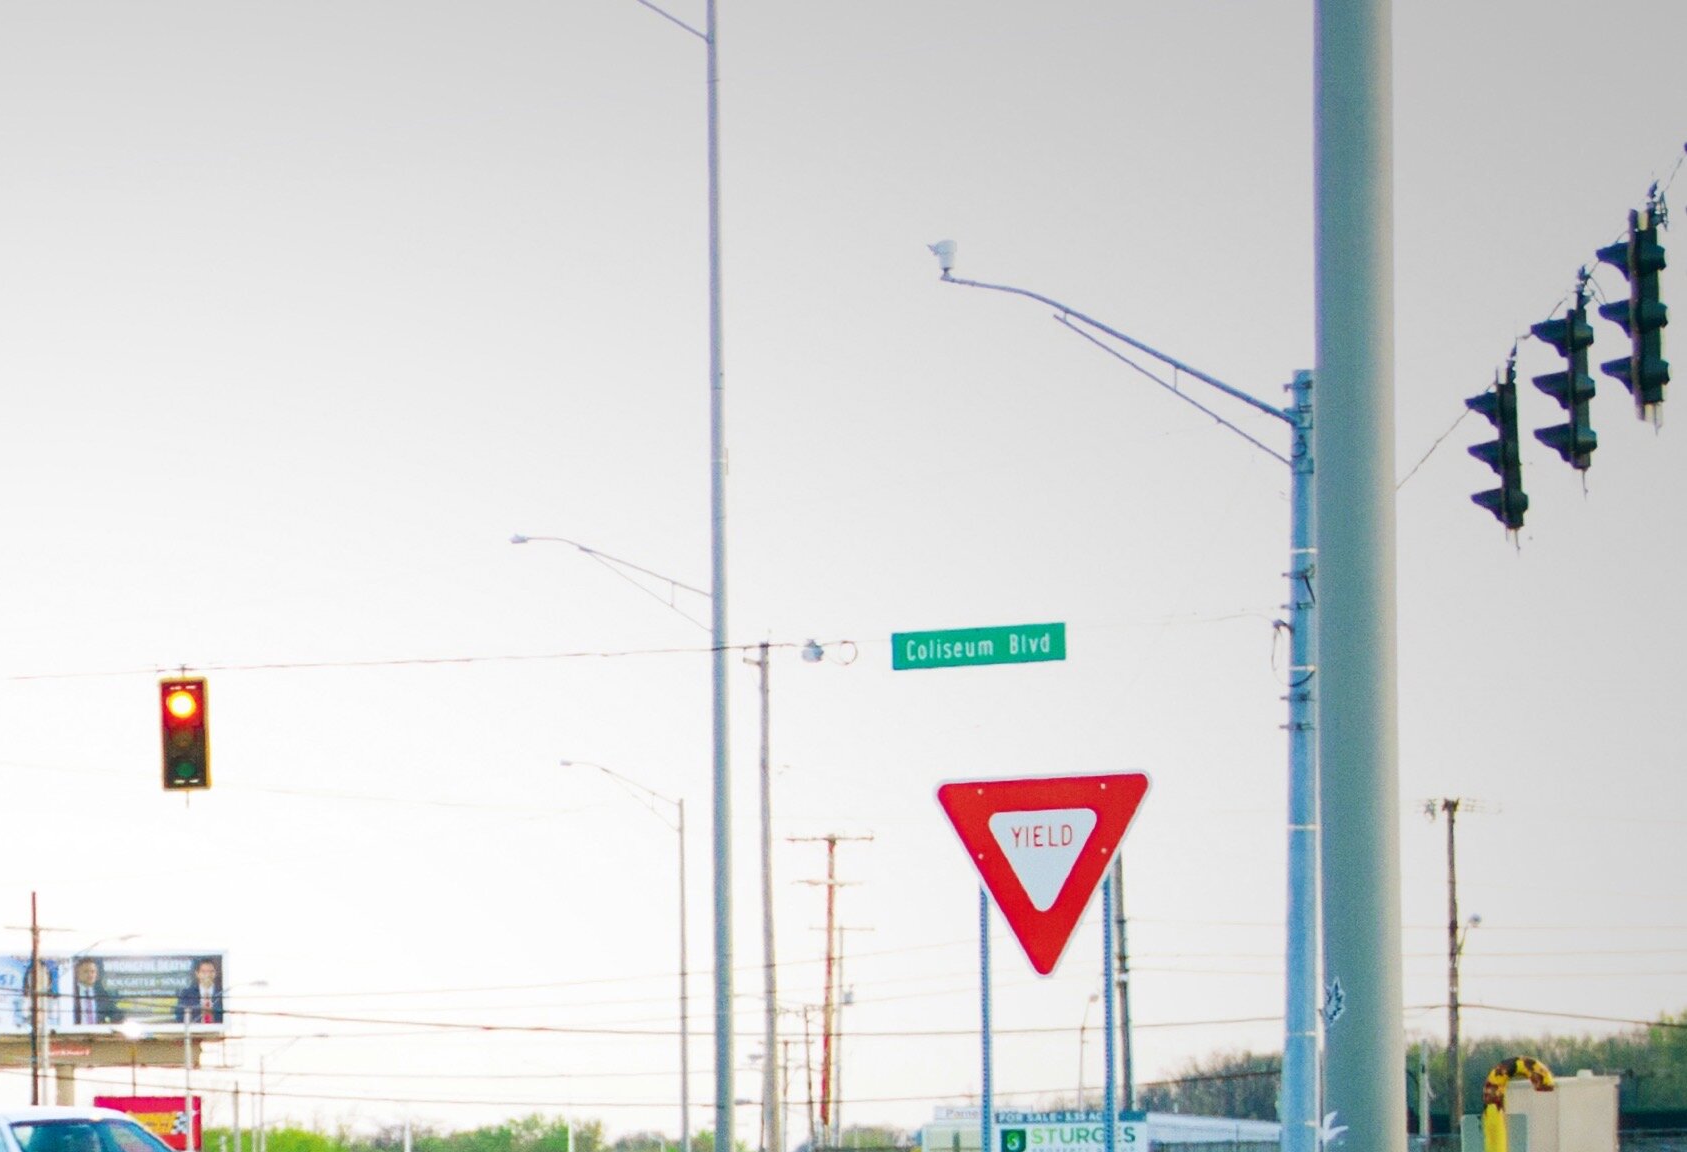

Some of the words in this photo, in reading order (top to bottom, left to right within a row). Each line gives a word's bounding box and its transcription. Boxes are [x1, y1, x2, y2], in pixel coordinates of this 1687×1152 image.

[906, 639, 994, 661] Coliseum
[1009, 633, 1051, 655] Blvd
[1010, 824, 1073, 848] YIELD
[998, 1112, 1023, 1123] FOR
[1031, 1127, 1136, 1145] STURGS
